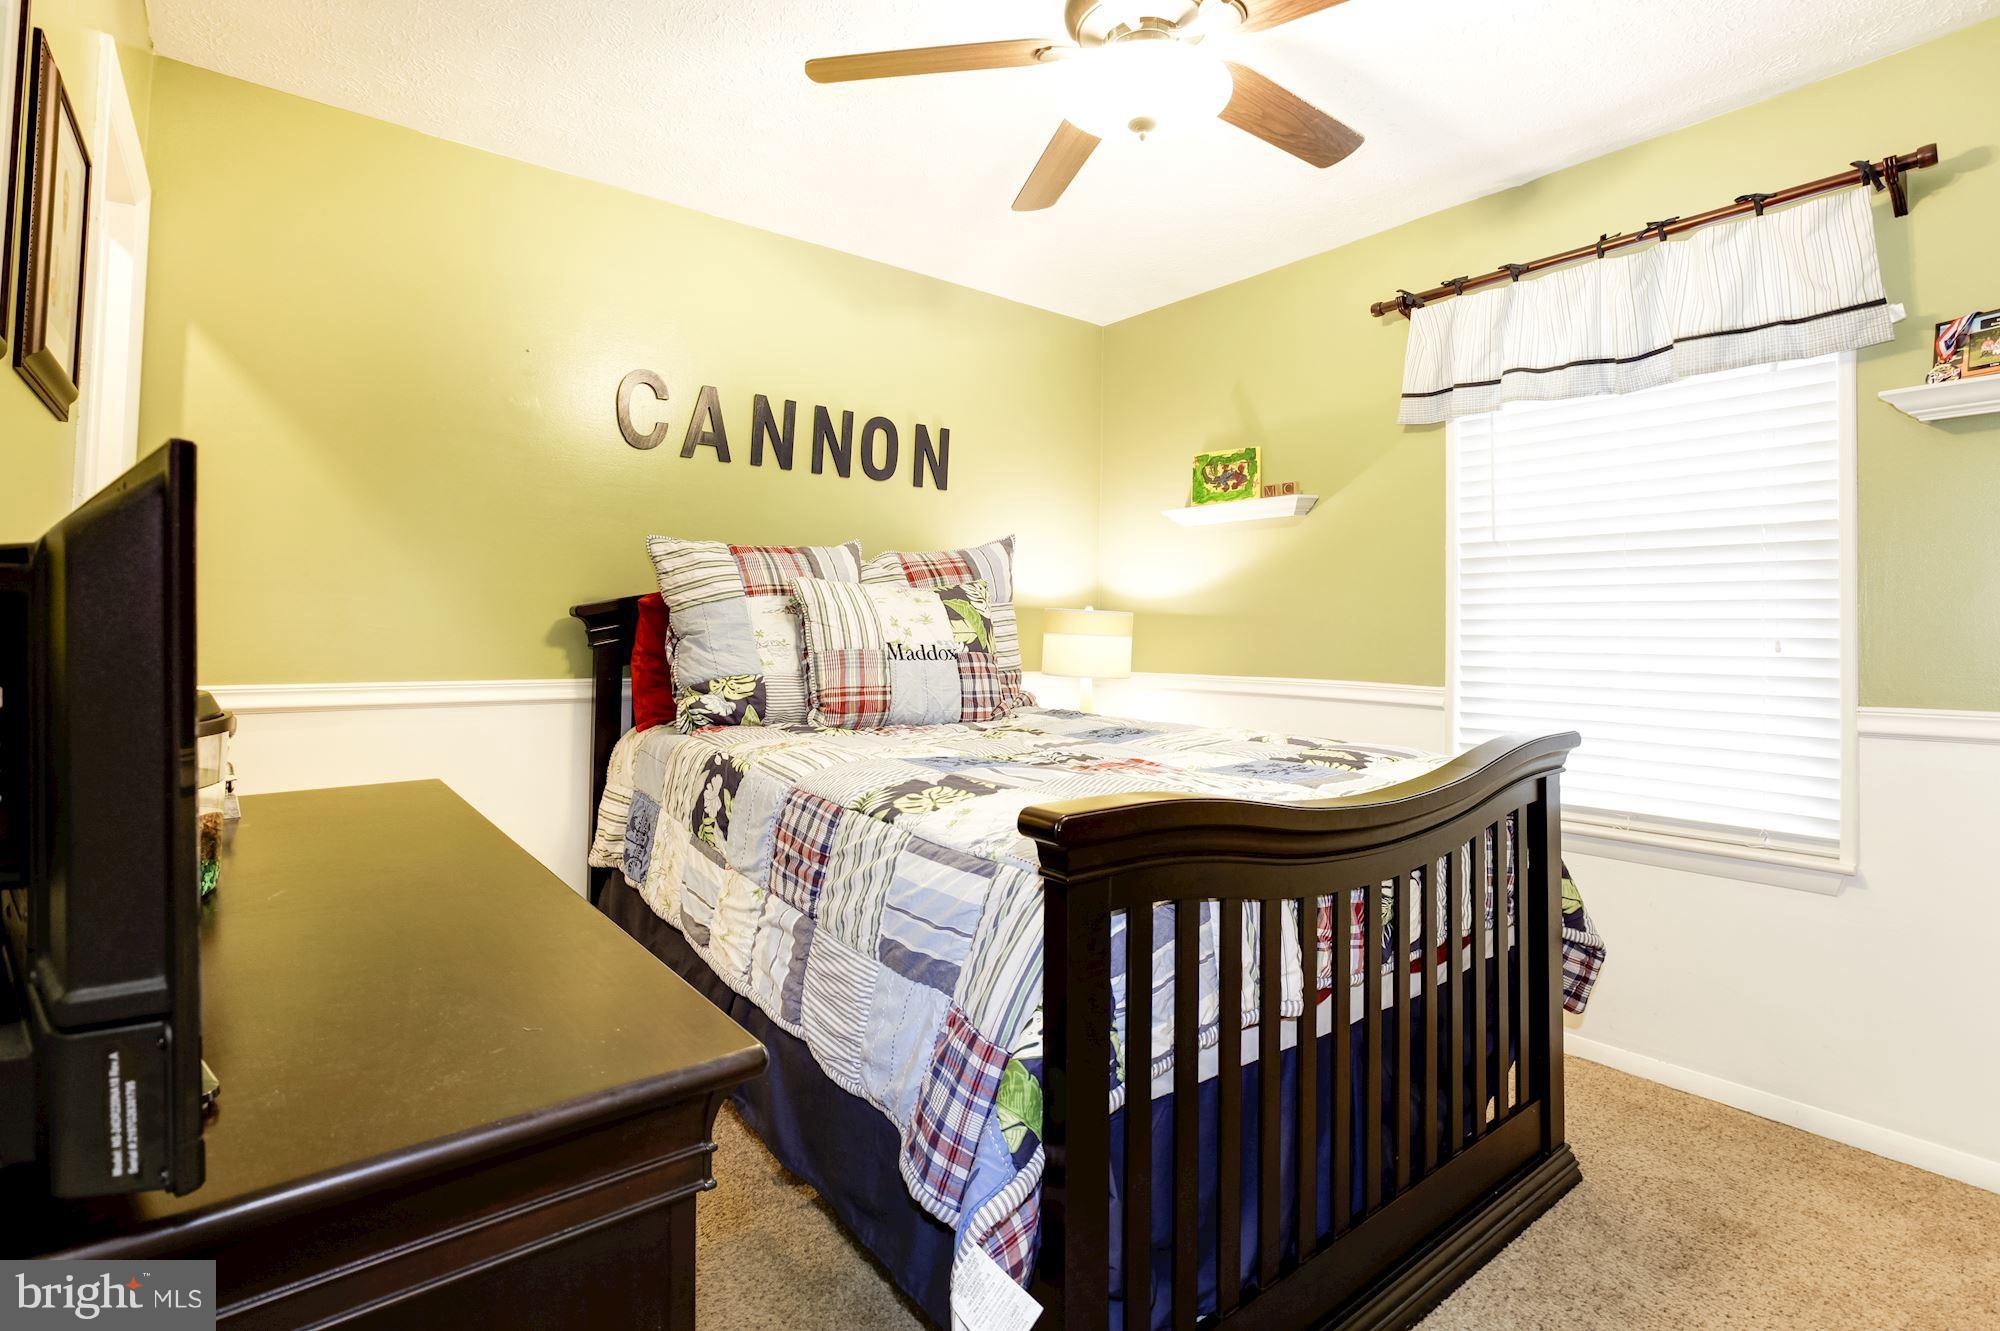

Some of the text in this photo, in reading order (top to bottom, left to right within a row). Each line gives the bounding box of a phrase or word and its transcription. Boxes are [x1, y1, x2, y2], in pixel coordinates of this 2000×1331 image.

[616, 368, 950, 491] CANNON
[1264, 486, 1275, 497] M
[886, 642, 959, 661] Maddox
